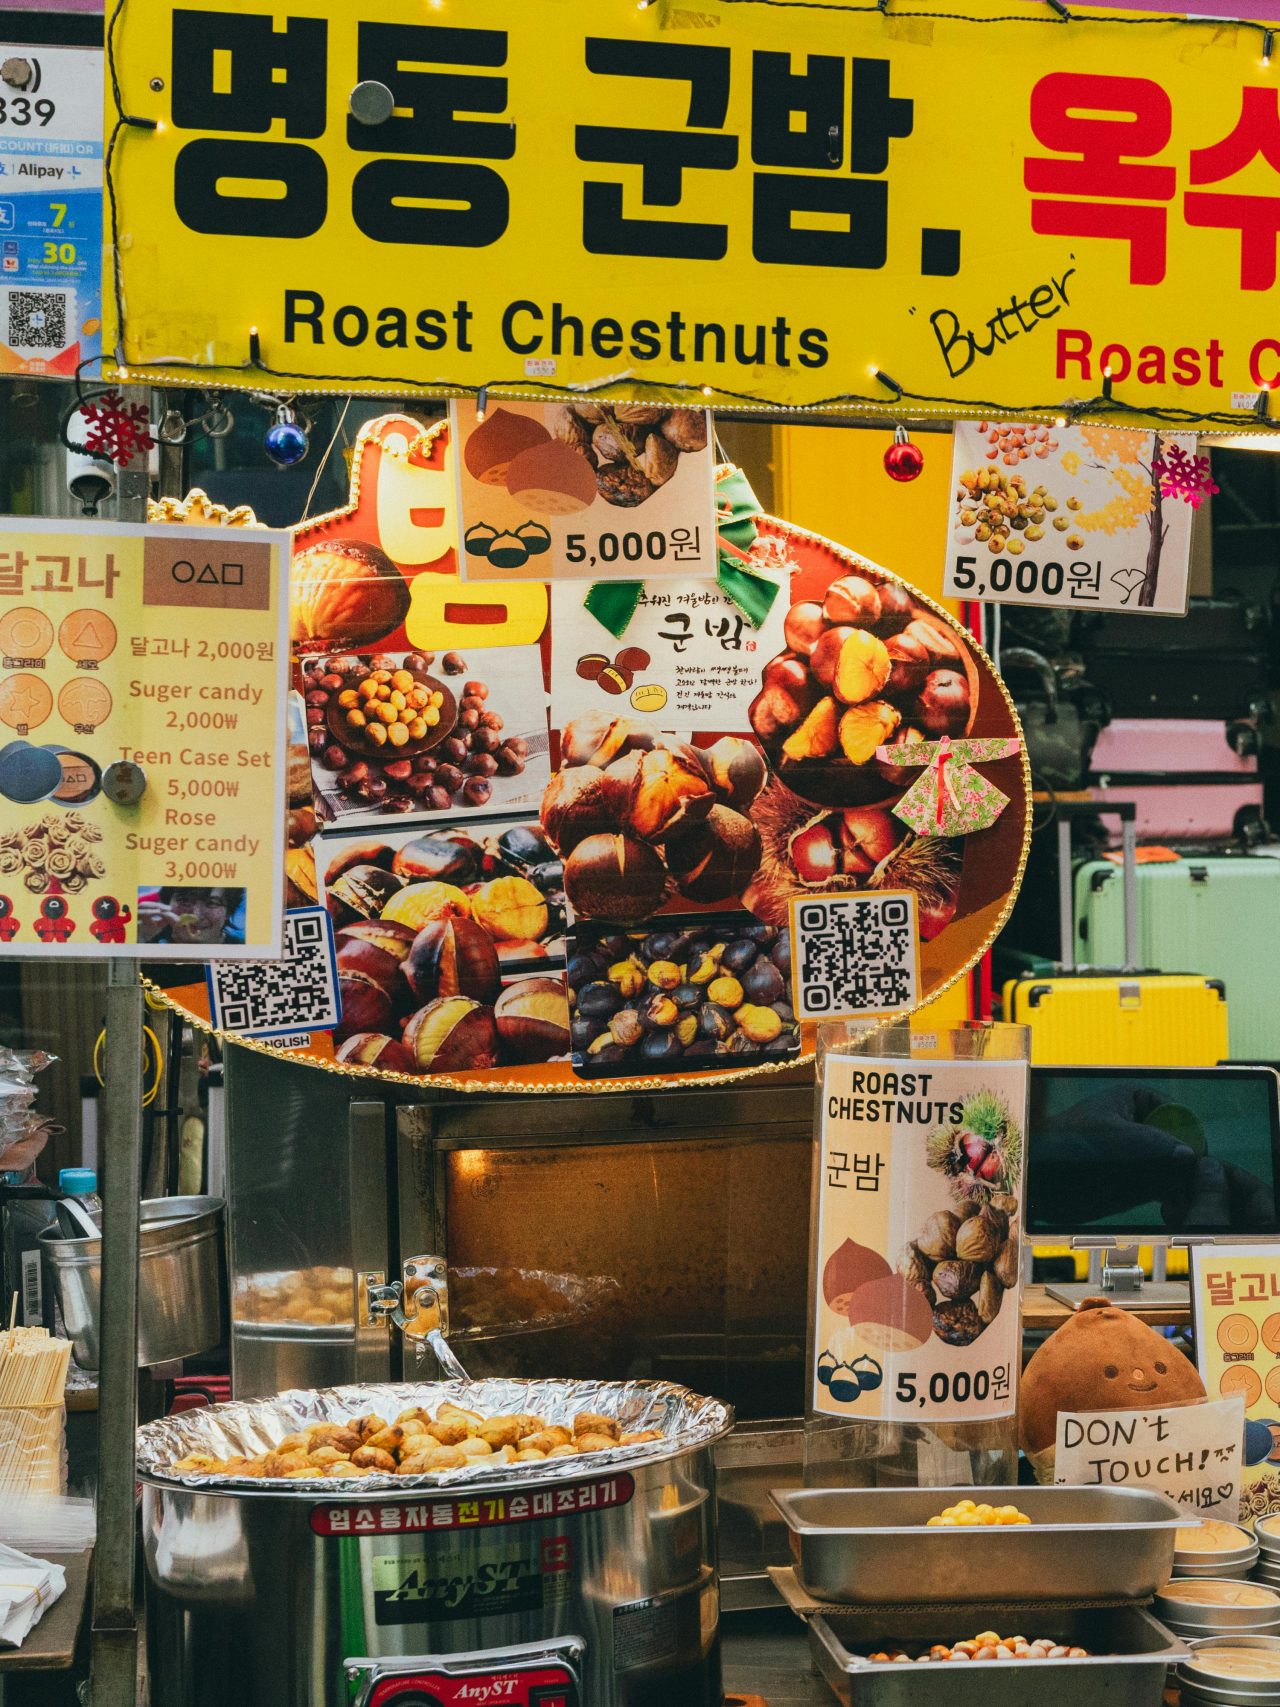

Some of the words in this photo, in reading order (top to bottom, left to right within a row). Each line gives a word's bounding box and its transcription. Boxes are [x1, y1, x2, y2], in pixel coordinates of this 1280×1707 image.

[172, 8, 516, 248] 명동
[18, 164, 64, 180] Alipay
[50, 203, 67, 228] 7
[43, 242, 76, 264] 30
[284, 290, 473, 352] Roast
[502, 301, 829, 368] Chestnuts
[1056, 329, 1223, 388] Roast
[565, 526, 702, 567] 5,000원
[0, 551, 120, 599] 달고나
[953, 556, 1102, 600] 5,000원
[130, 636, 190, 658] 달고나
[196, 640, 275, 662] 2,000원
[129, 680, 193, 702] Suger
[199, 683, 264, 705] candy
[119, 747, 172, 765] Teen
[179, 749, 229, 767] Case
[237, 750, 272, 767] Set
[165, 809, 217, 826] Rose
[125, 833, 189, 855] Suger
[195, 835, 260, 857] candy
[260, 1035, 310, 1048] NGLISH
[852, 1071, 933, 1097] ROAST
[828, 1096, 964, 1125] CHESTNUTS
[827, 1151, 885, 1192] 군밤
[895, 1362, 1010, 1408] 5,000원
[452, 1680, 519, 1702] AnyST
